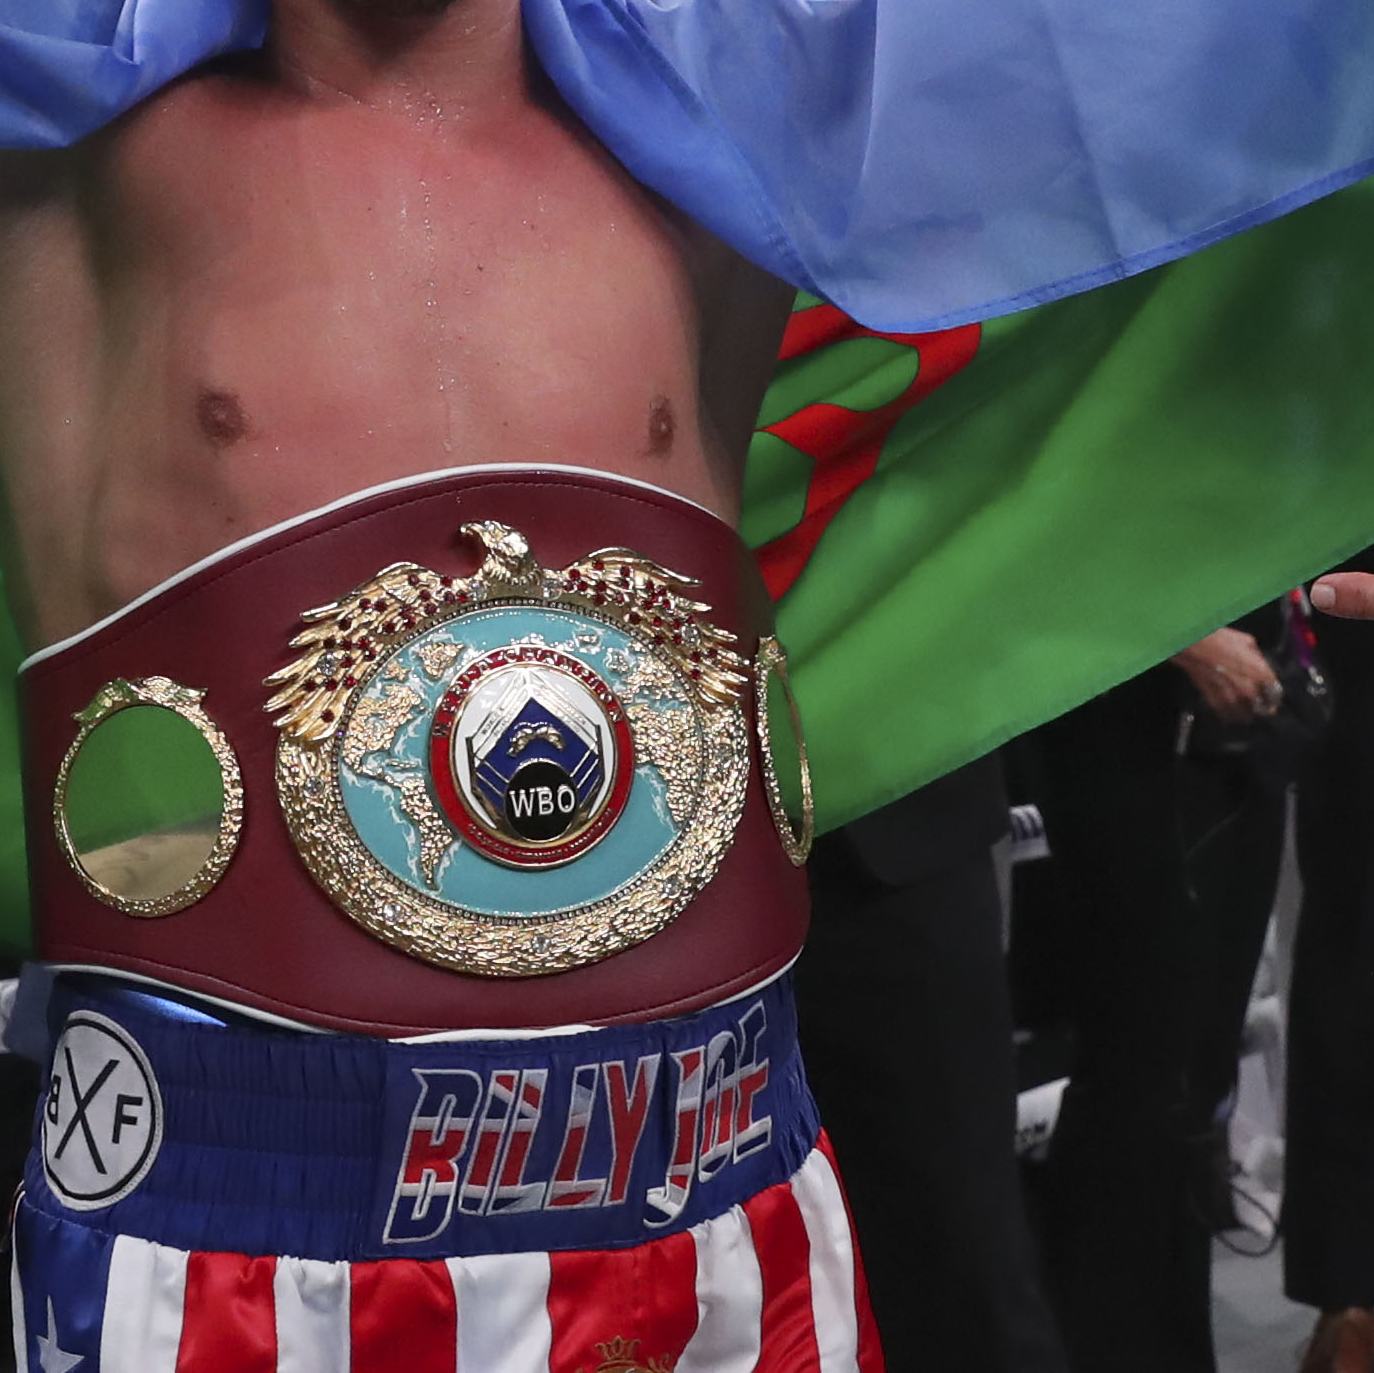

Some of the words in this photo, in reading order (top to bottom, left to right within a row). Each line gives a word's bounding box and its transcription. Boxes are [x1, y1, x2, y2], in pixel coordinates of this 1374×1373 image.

[508, 783, 576, 819] WBO
[382, 1052, 662, 1245] BILLY
[642, 998, 772, 1229] JOE
